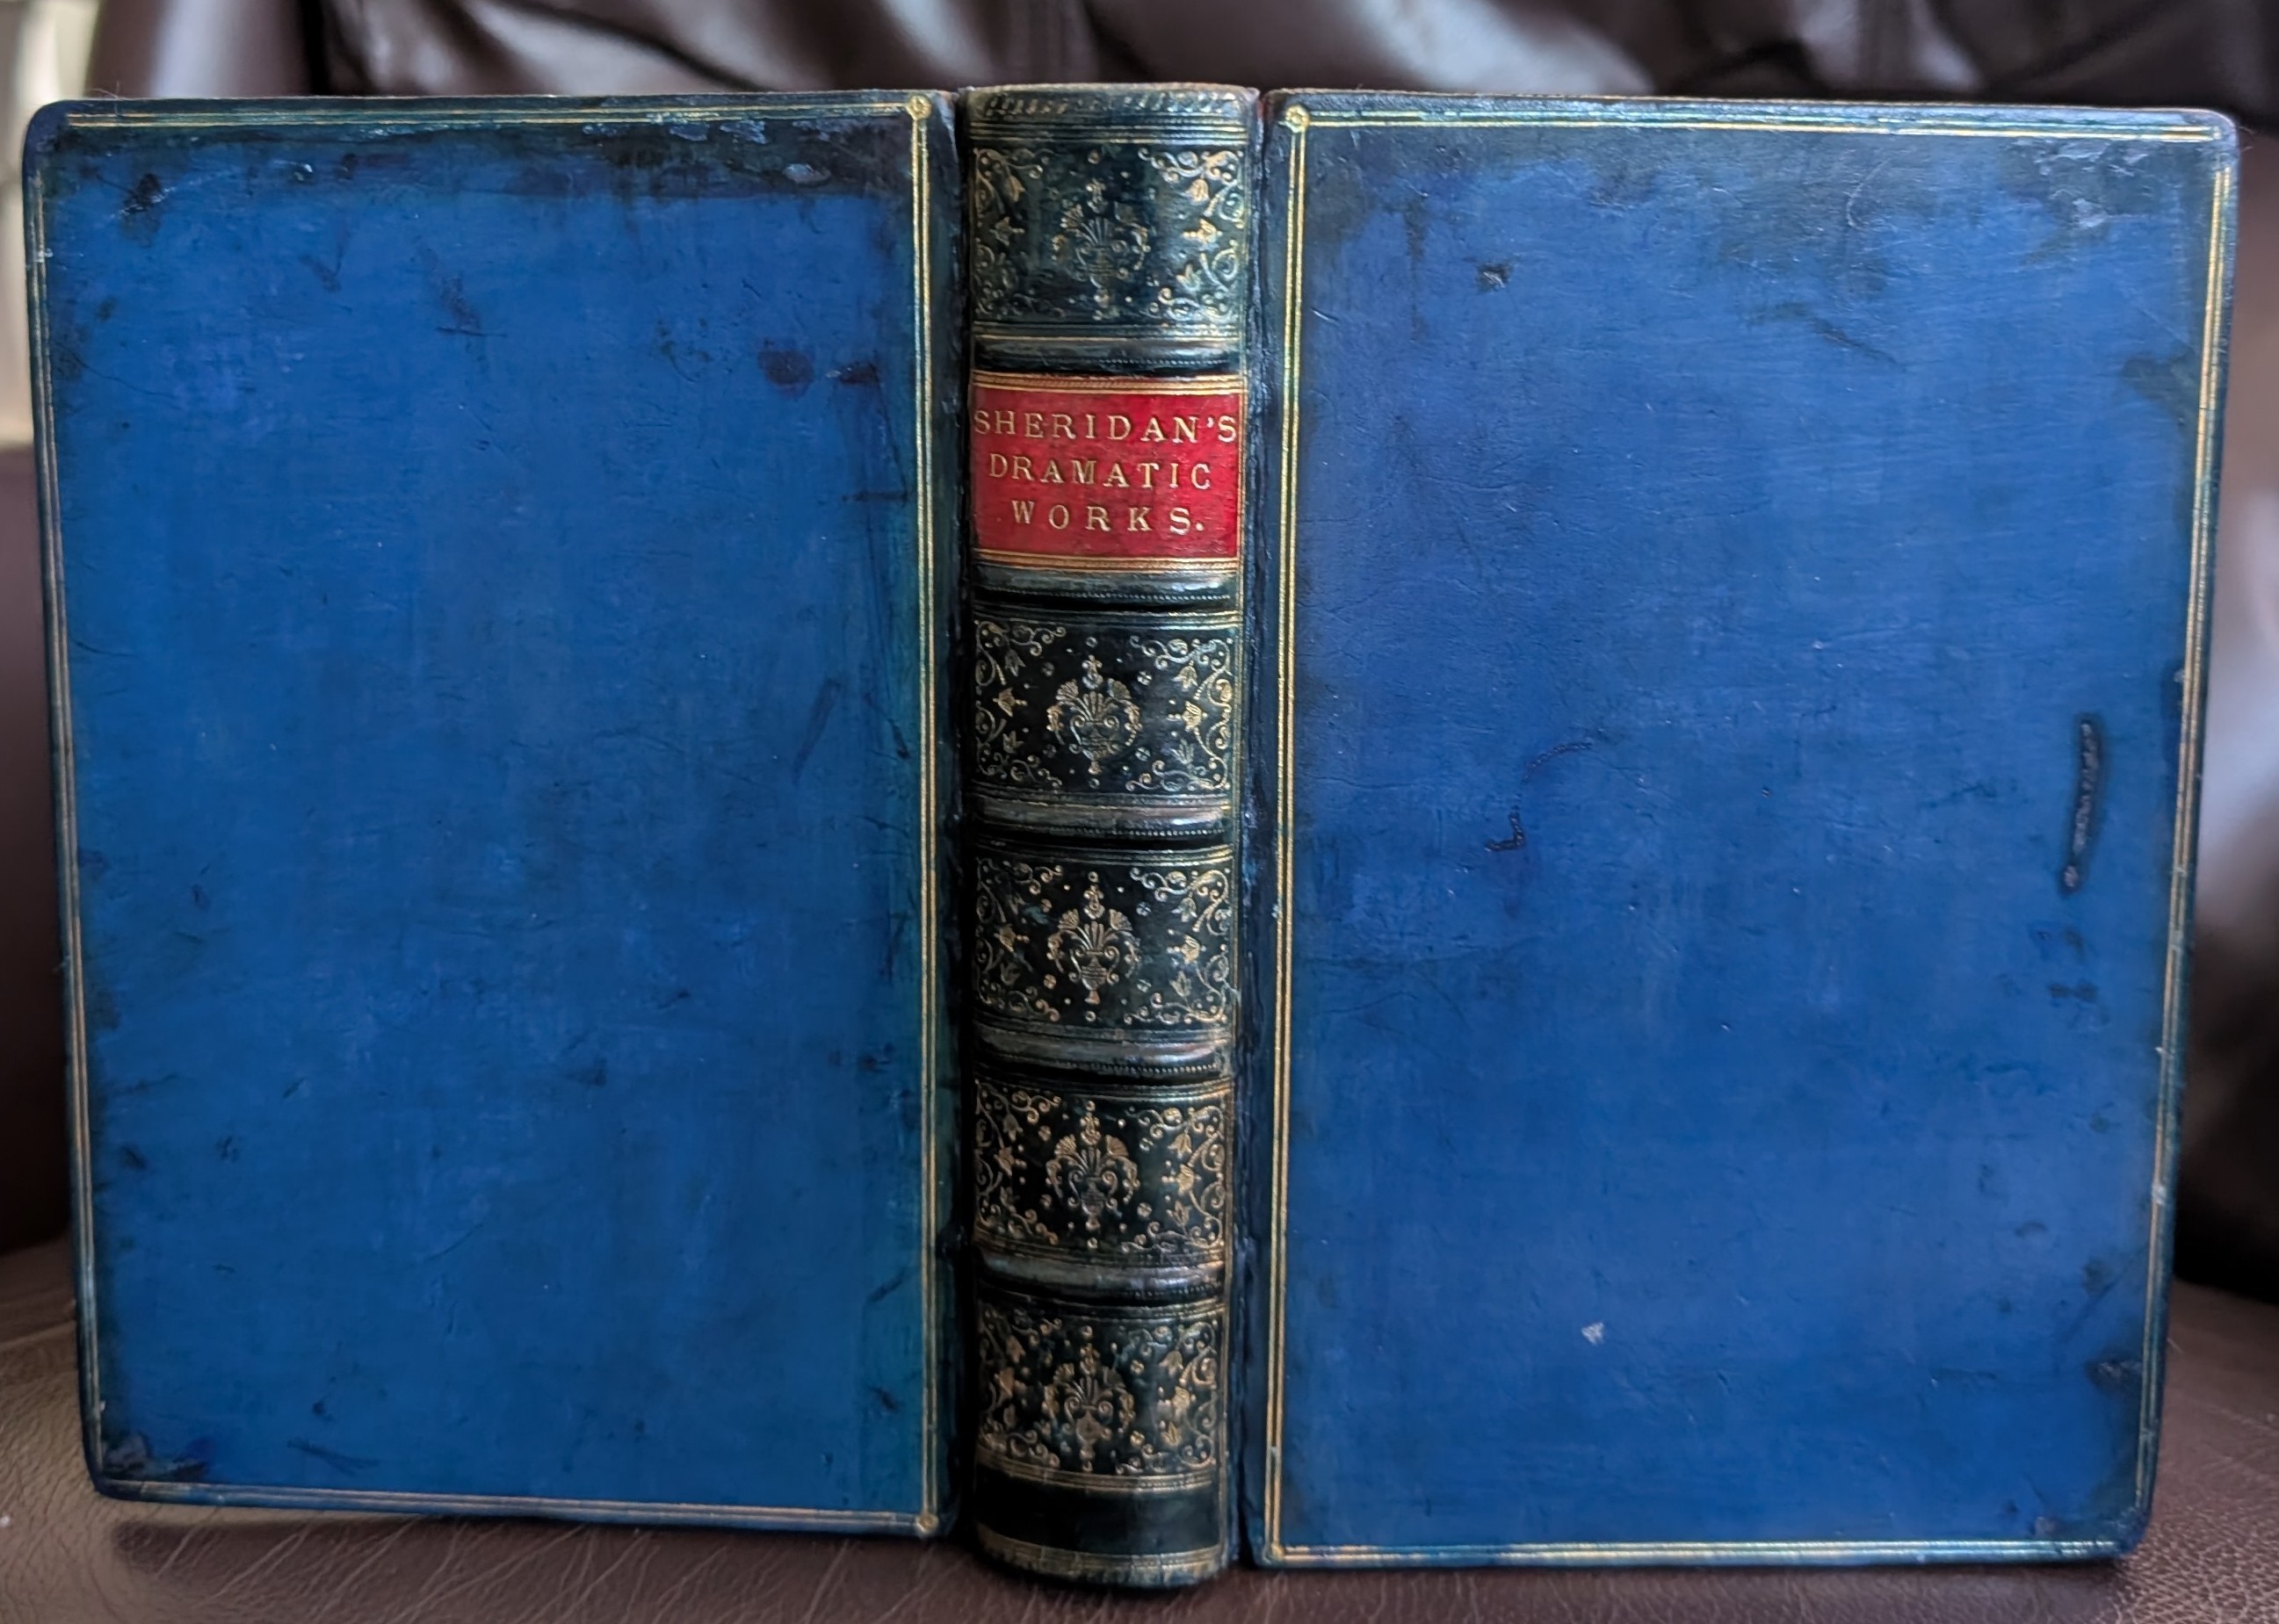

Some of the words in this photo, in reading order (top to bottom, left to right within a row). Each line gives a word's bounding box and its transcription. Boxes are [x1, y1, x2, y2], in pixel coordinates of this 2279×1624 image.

[973, 409, 1237, 444] SHERIDAN'S
[988, 453, 1211, 490] DRAMATIC
[1011, 500, 1204, 536] WORKS.
